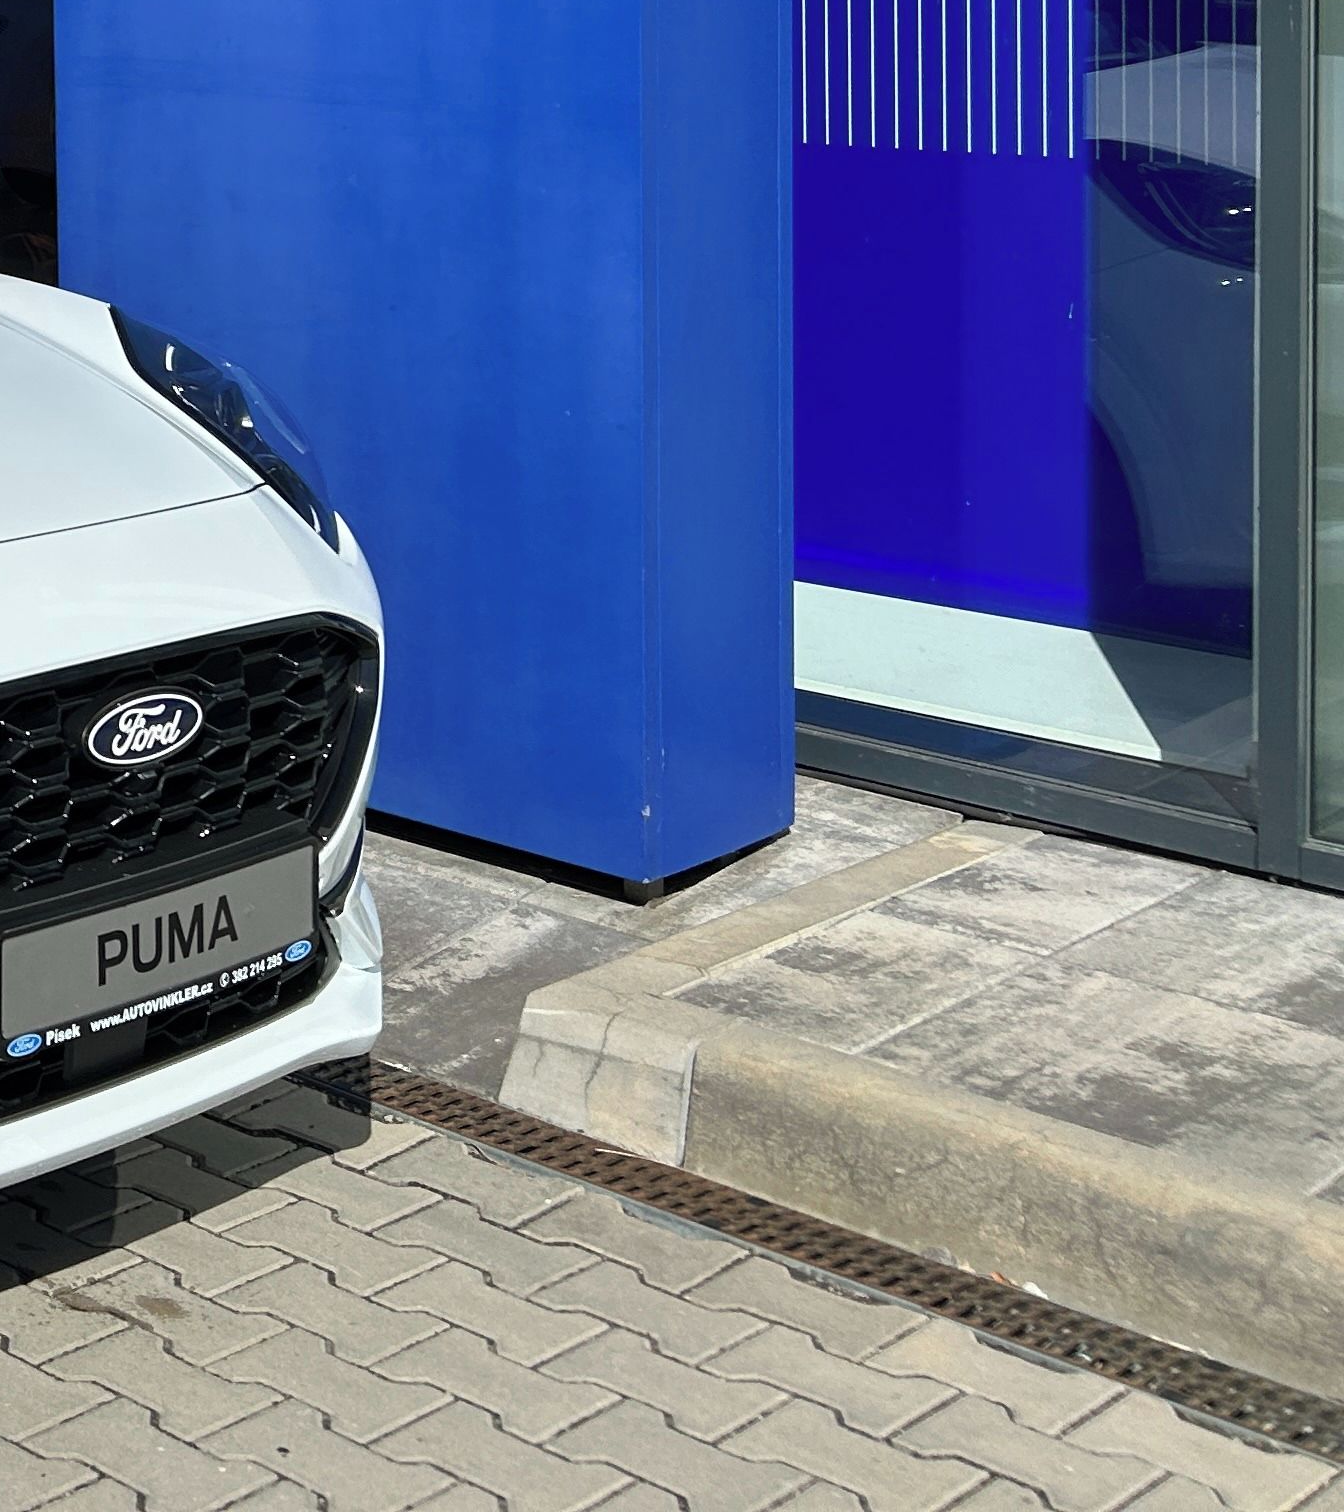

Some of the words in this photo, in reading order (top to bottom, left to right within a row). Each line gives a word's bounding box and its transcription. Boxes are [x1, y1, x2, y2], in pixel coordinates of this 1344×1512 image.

[112, 703, 183, 756] Ford
[96, 894, 239, 987] PUMA
[90, 982, 214, 1032] www.AUTOVINKLER.cz
